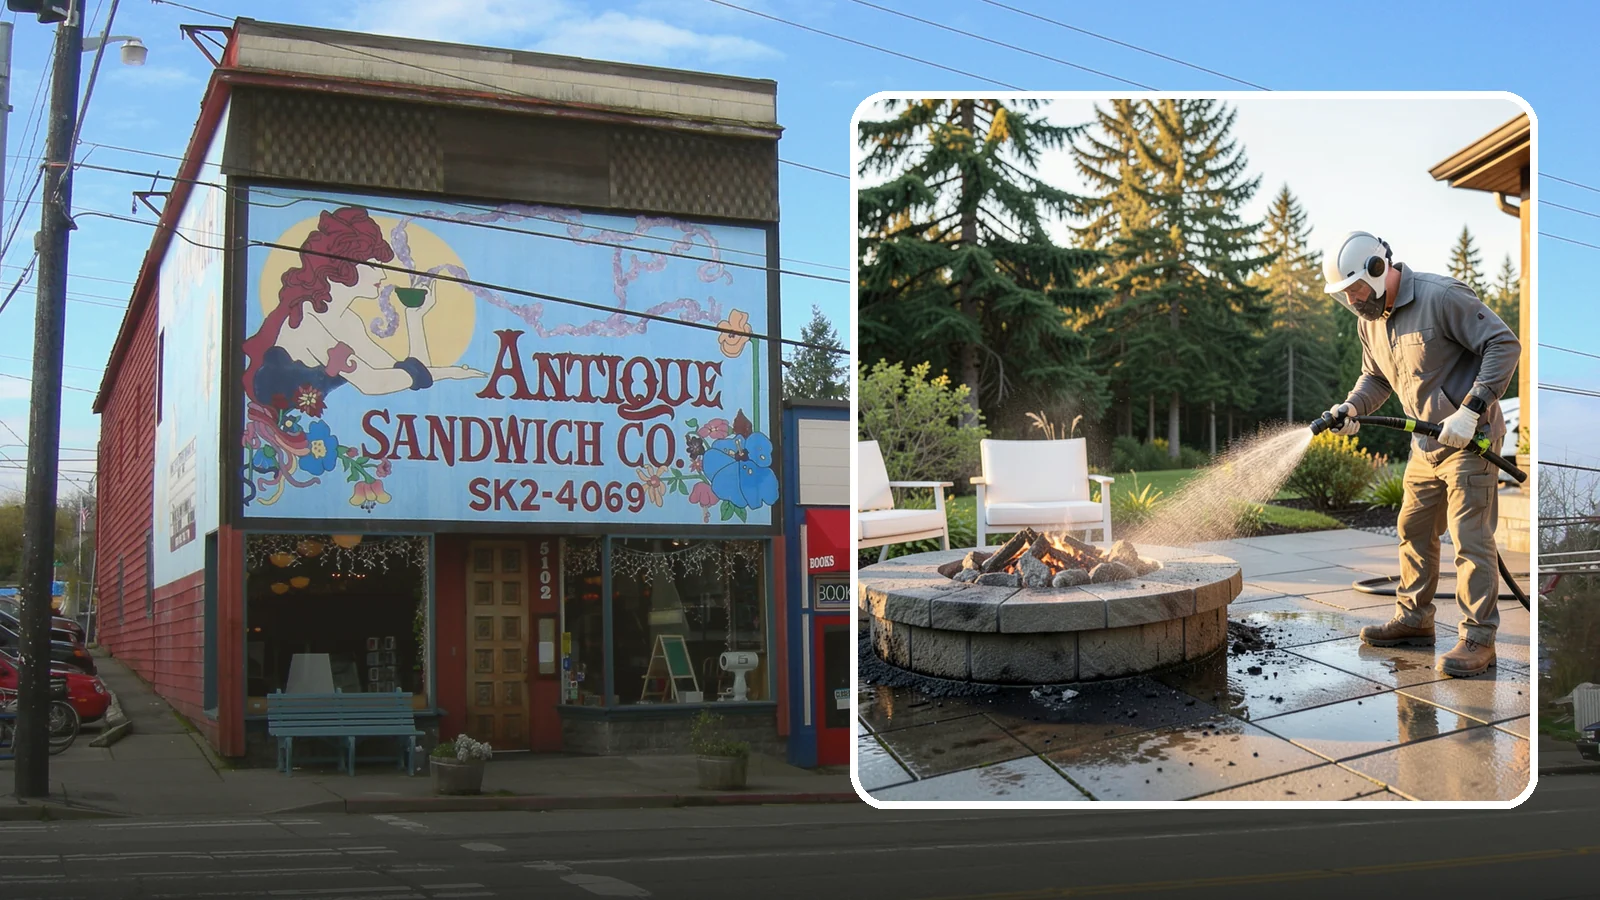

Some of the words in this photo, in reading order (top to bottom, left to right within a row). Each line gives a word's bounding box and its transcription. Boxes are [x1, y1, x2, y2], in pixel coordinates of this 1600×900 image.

[476, 329, 723, 420] ANTIQUE
[361, 408, 604, 467] SANDWICH
[616, 421, 685, 469] CO.
[468, 476, 646, 513] SK2-4069
[540, 541, 551, 600] 5102
[809, 555, 835, 569] BOOKS
